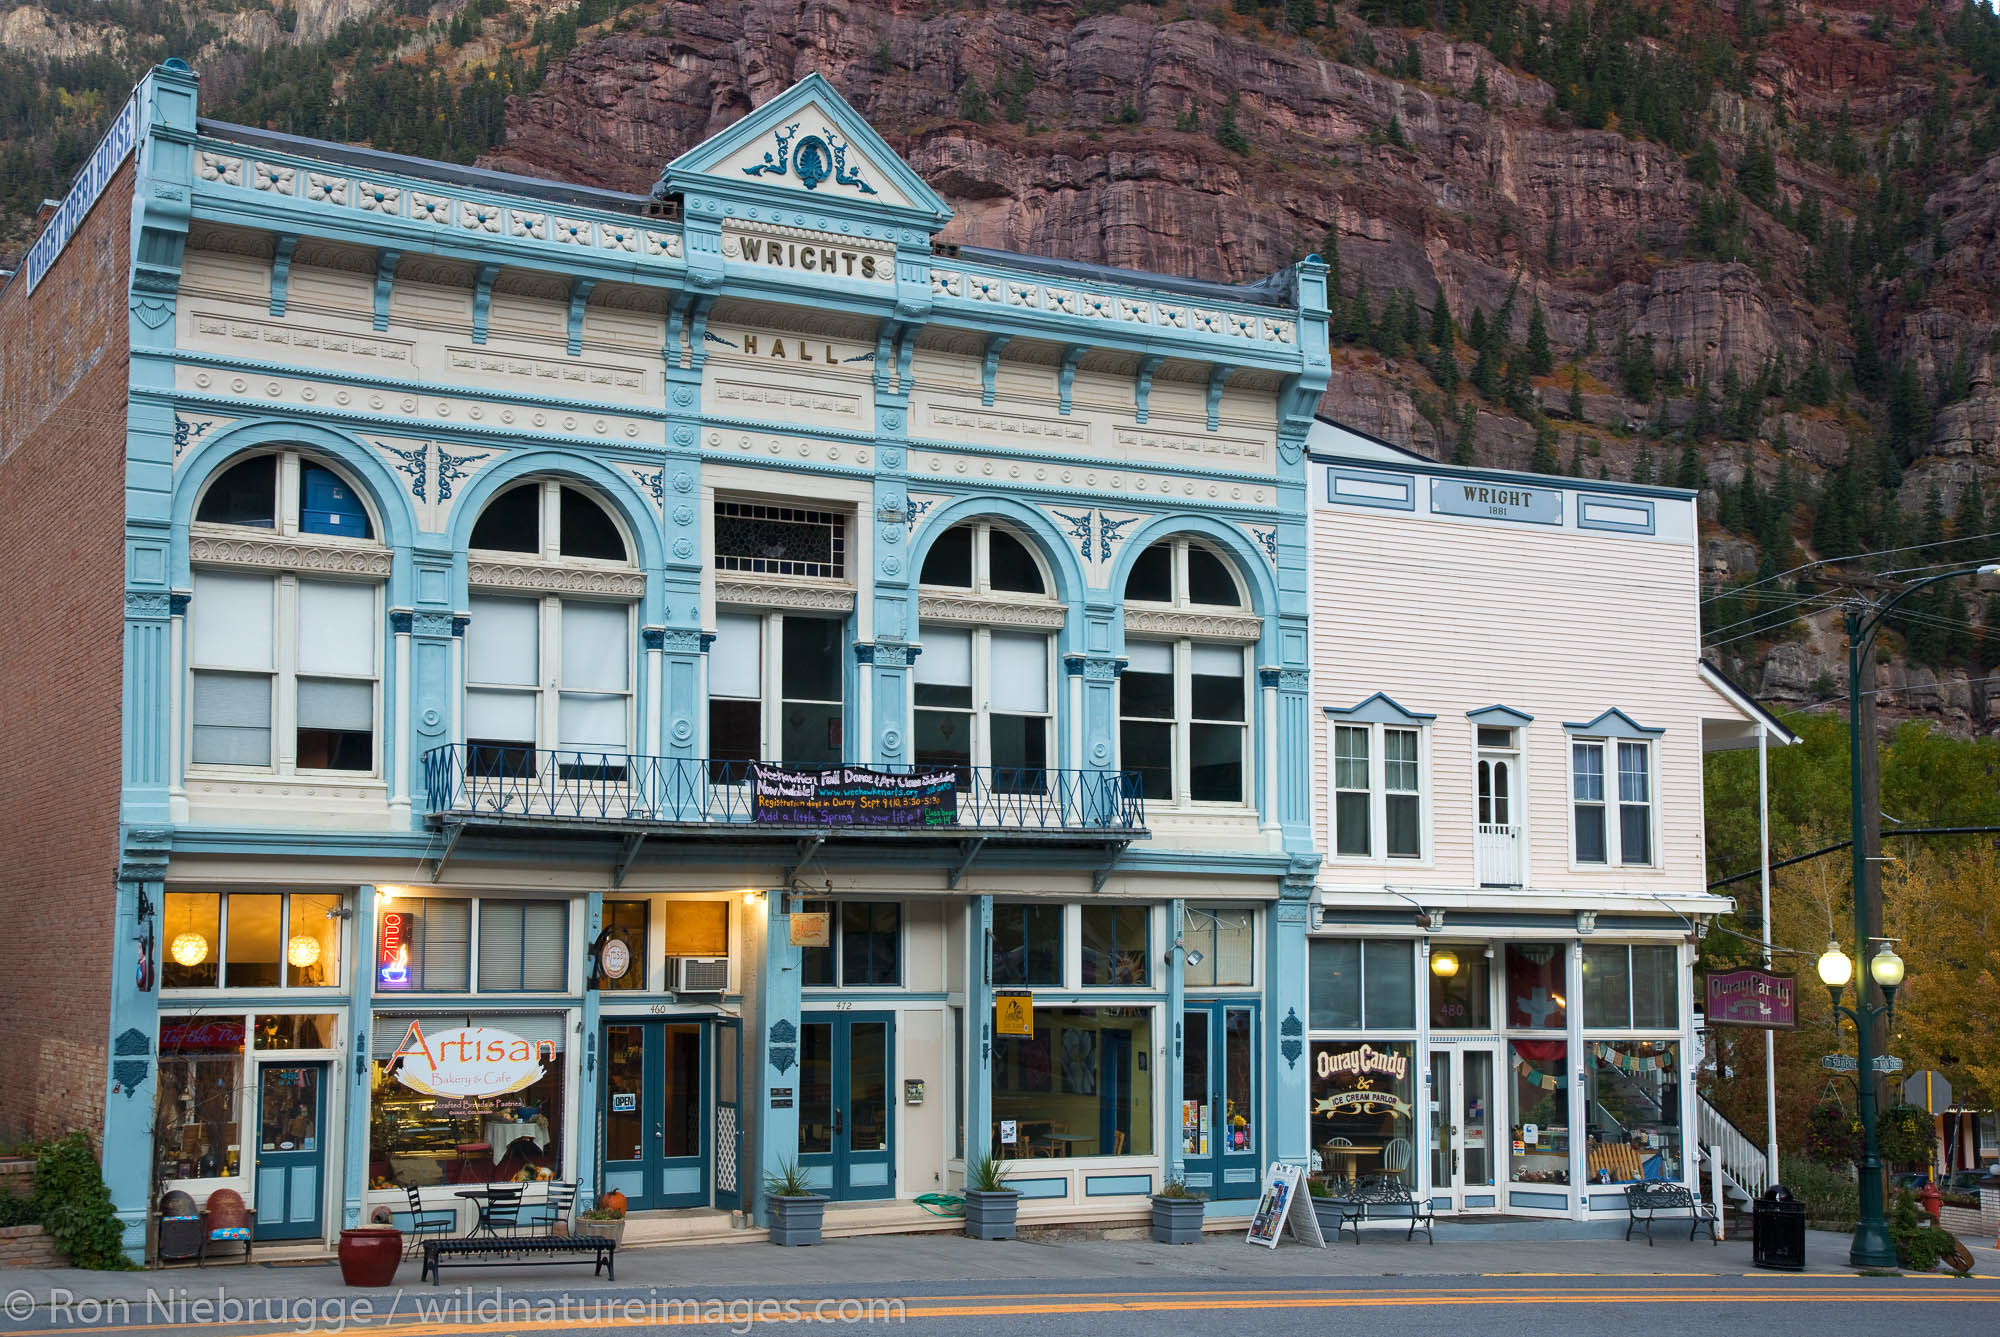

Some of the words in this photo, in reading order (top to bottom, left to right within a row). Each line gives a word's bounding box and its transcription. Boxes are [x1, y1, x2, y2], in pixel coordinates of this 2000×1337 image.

[28, 210, 63, 289] WRIGHT
[64, 163, 94, 240] OPERA
[95, 107, 132, 193] HOUSE
[740, 236, 876, 278] WRIGHTS
[744, 334, 839, 364] HALL
[1463, 486, 1533, 508] WRIGHT
[1488, 506, 1508, 516] 1881
[753, 764, 819, 785] Weehawken
[821, 770, 840, 786] Fall
[844, 769, 873, 784] Dance
[879, 774, 896, 787] Art
[757, 780, 778, 796] Now
[758, 795, 805, 808] Registration
[832, 797, 856, 808] Ouray
[882, 798, 888, 808] 9
[757, 808, 779, 822] Add
[793, 808, 815, 822] little
[871, 815, 891, 825] your
[892, 809, 921, 825] life!
[384, 914, 401, 961] OPEN
[1711, 978, 1749, 999] Ouray
[650, 1004, 666, 1014] 460
[836, 1001, 852, 1010] 472
[1440, 1004, 1464, 1016] 480
[383, 1019, 557, 1073] Artisan
[1317, 1050, 1360, 1078] Ouray
[1359, 1043, 1407, 1080] Candy
[431, 1072, 470, 1088] Bakery
[1356, 1075, 1374, 1090] &
[615, 1096, 634, 1107] OPEN
[1332, 1096, 1344, 1106] ICE
[1345, 1093, 1370, 1103] CREAM
[1372, 1093, 1397, 1105] PARLOR
